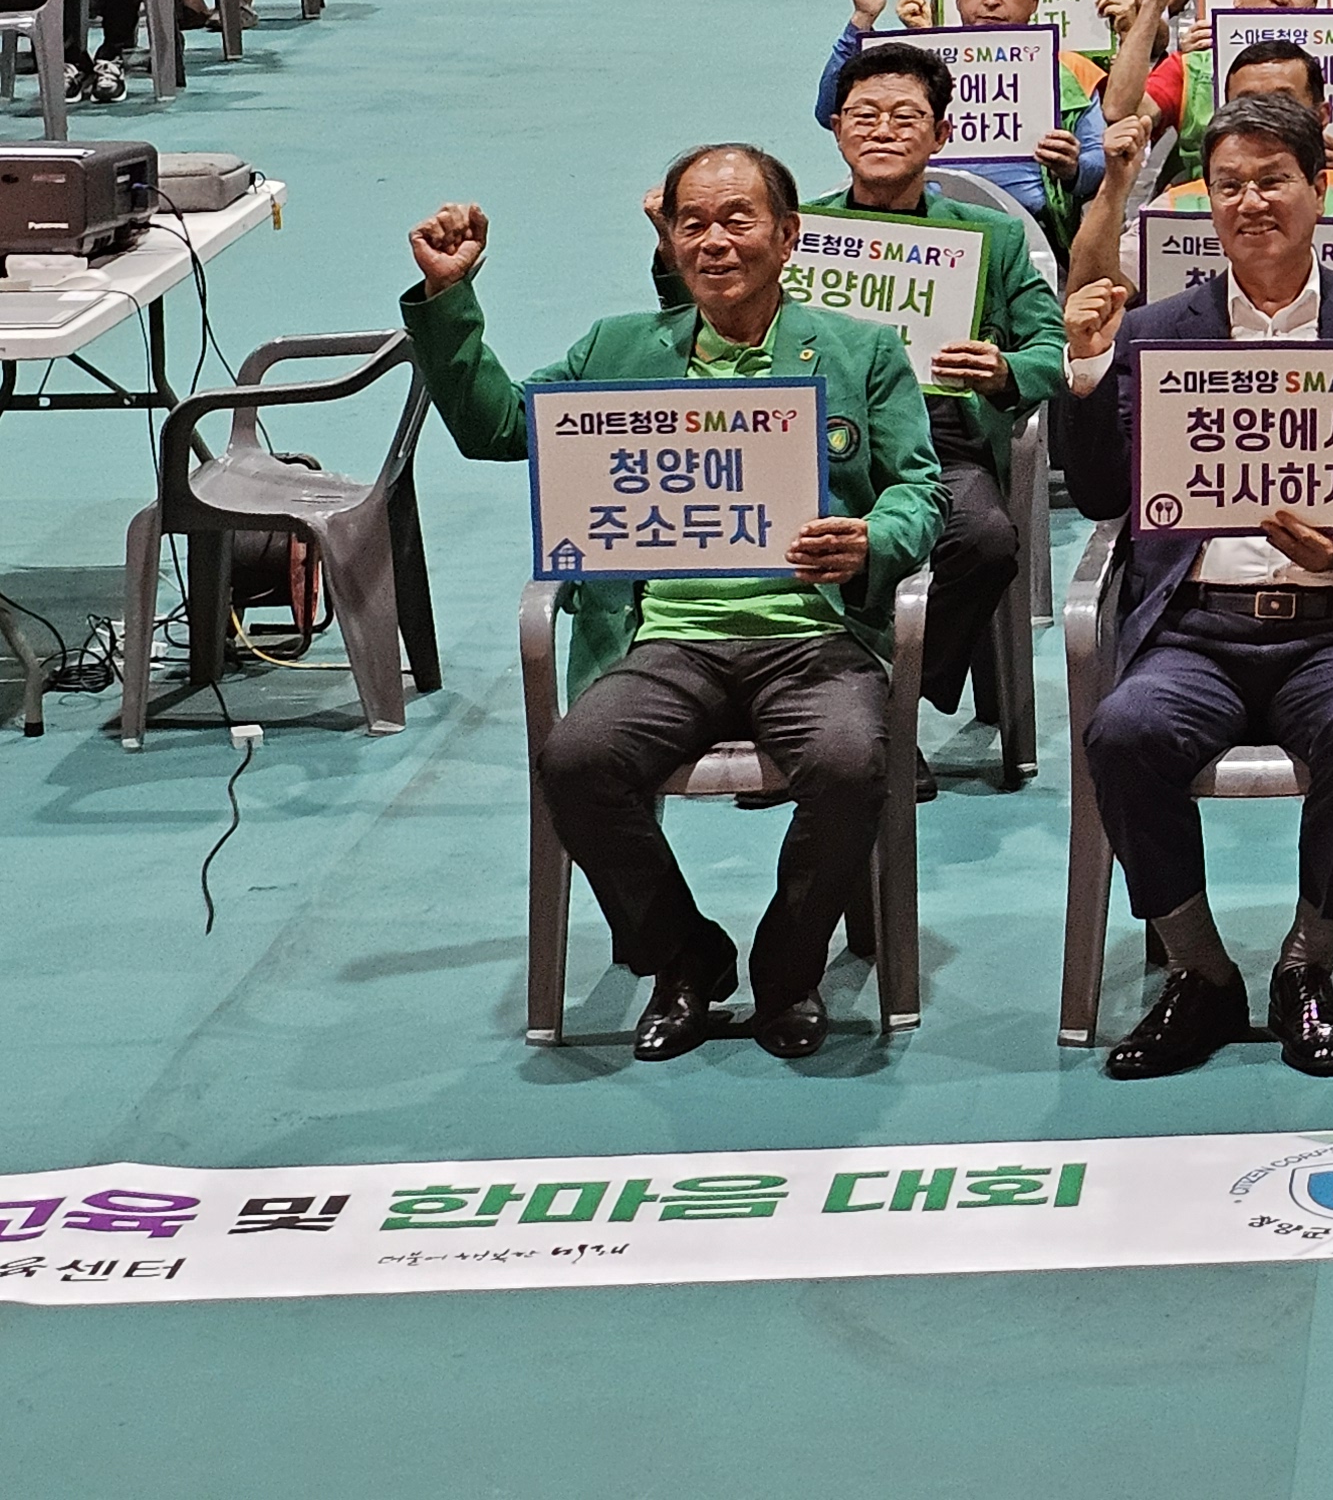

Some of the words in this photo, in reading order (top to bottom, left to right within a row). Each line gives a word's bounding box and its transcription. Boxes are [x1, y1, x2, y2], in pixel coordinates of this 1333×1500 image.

[781, 263, 936, 318] 청양에서
[1159, 369, 1279, 394] 스마트청양
[555, 410, 678, 436] 스마트청양
[609, 447, 745, 494] 청양에
[587, 503, 772, 550] 주소두자
[227, 1194, 352, 1237] 및
[378, 1171, 788, 1232] 한마음
[821, 1161, 1088, 1214] 대회
